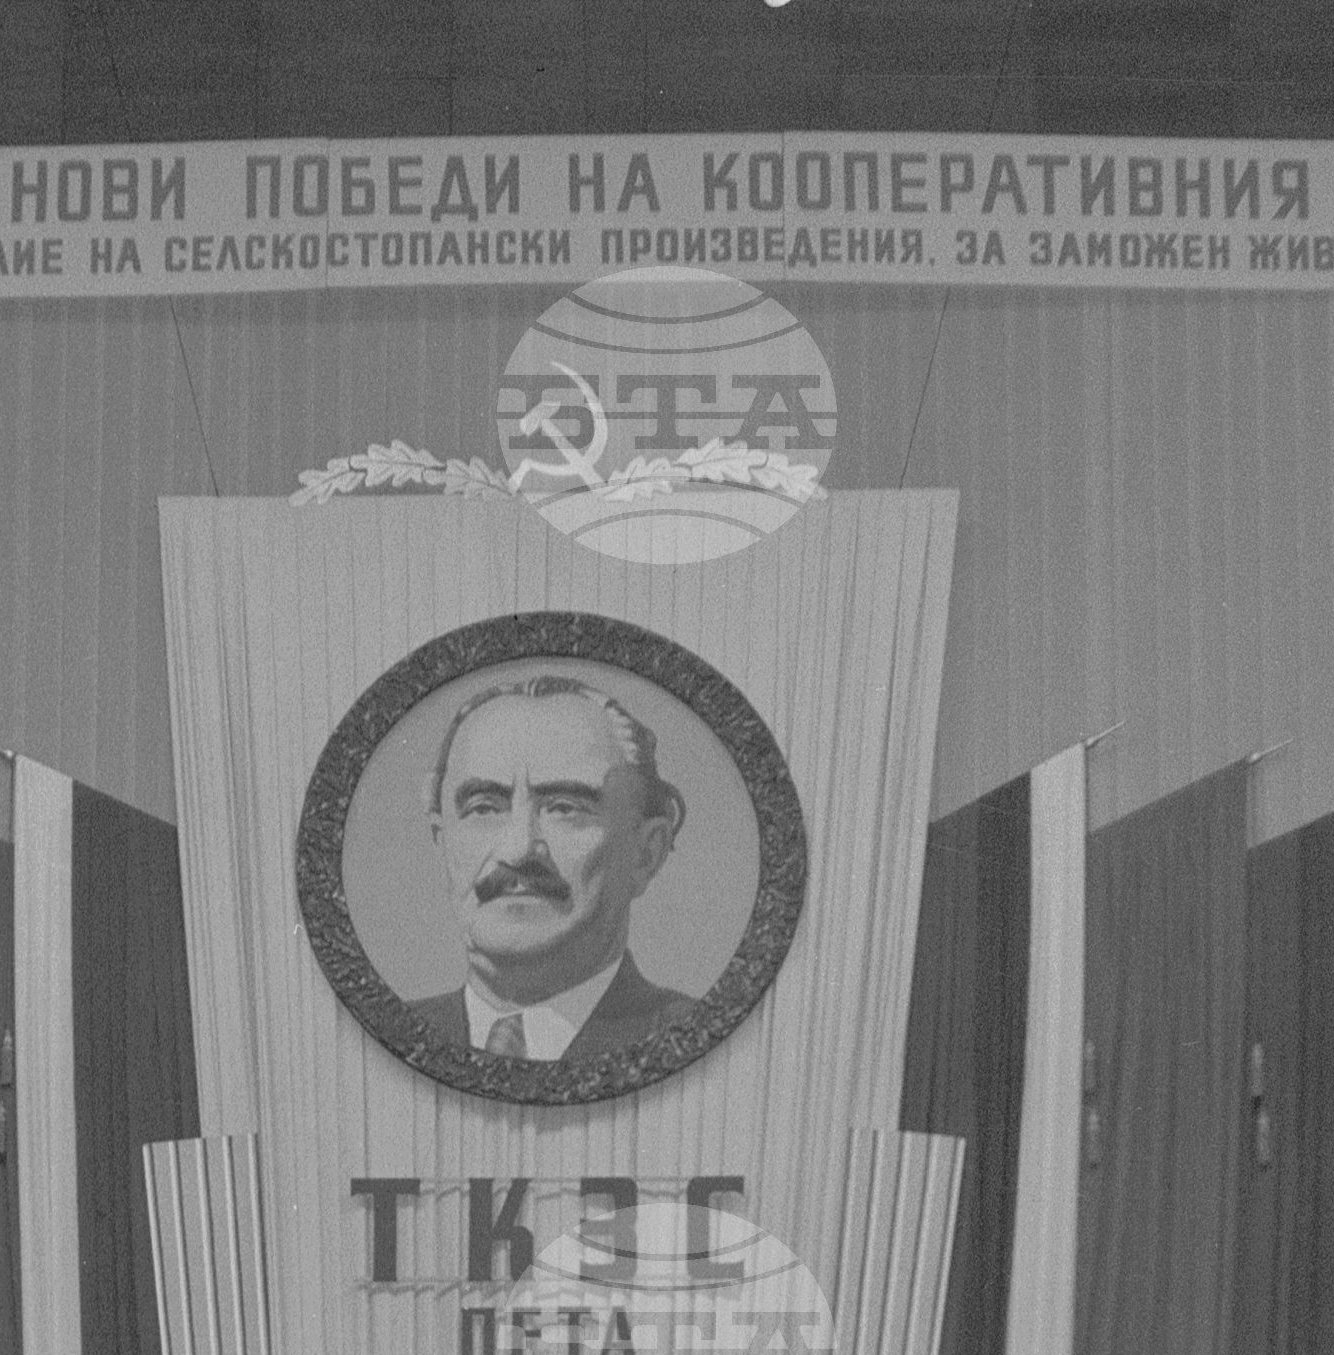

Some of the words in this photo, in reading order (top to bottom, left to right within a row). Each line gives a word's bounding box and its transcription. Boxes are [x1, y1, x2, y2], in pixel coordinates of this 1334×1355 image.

[11, 158, 186, 223] НОВИ
[246, 155, 520, 223] ПОБЕДИ
[568, 153, 660, 214] НА
[703, 151, 1309, 220] КООПЕРАТИВНИЯ
[90, 238, 141, 274] НА
[164, 230, 570, 272] СЕЛСКОСТОПАНСКИ
[956, 230, 1006, 265] ЗА
[1029, 231, 1230, 269] ЗАМОЖЕН
[351, 1176, 744, 1282] ТКЗС
